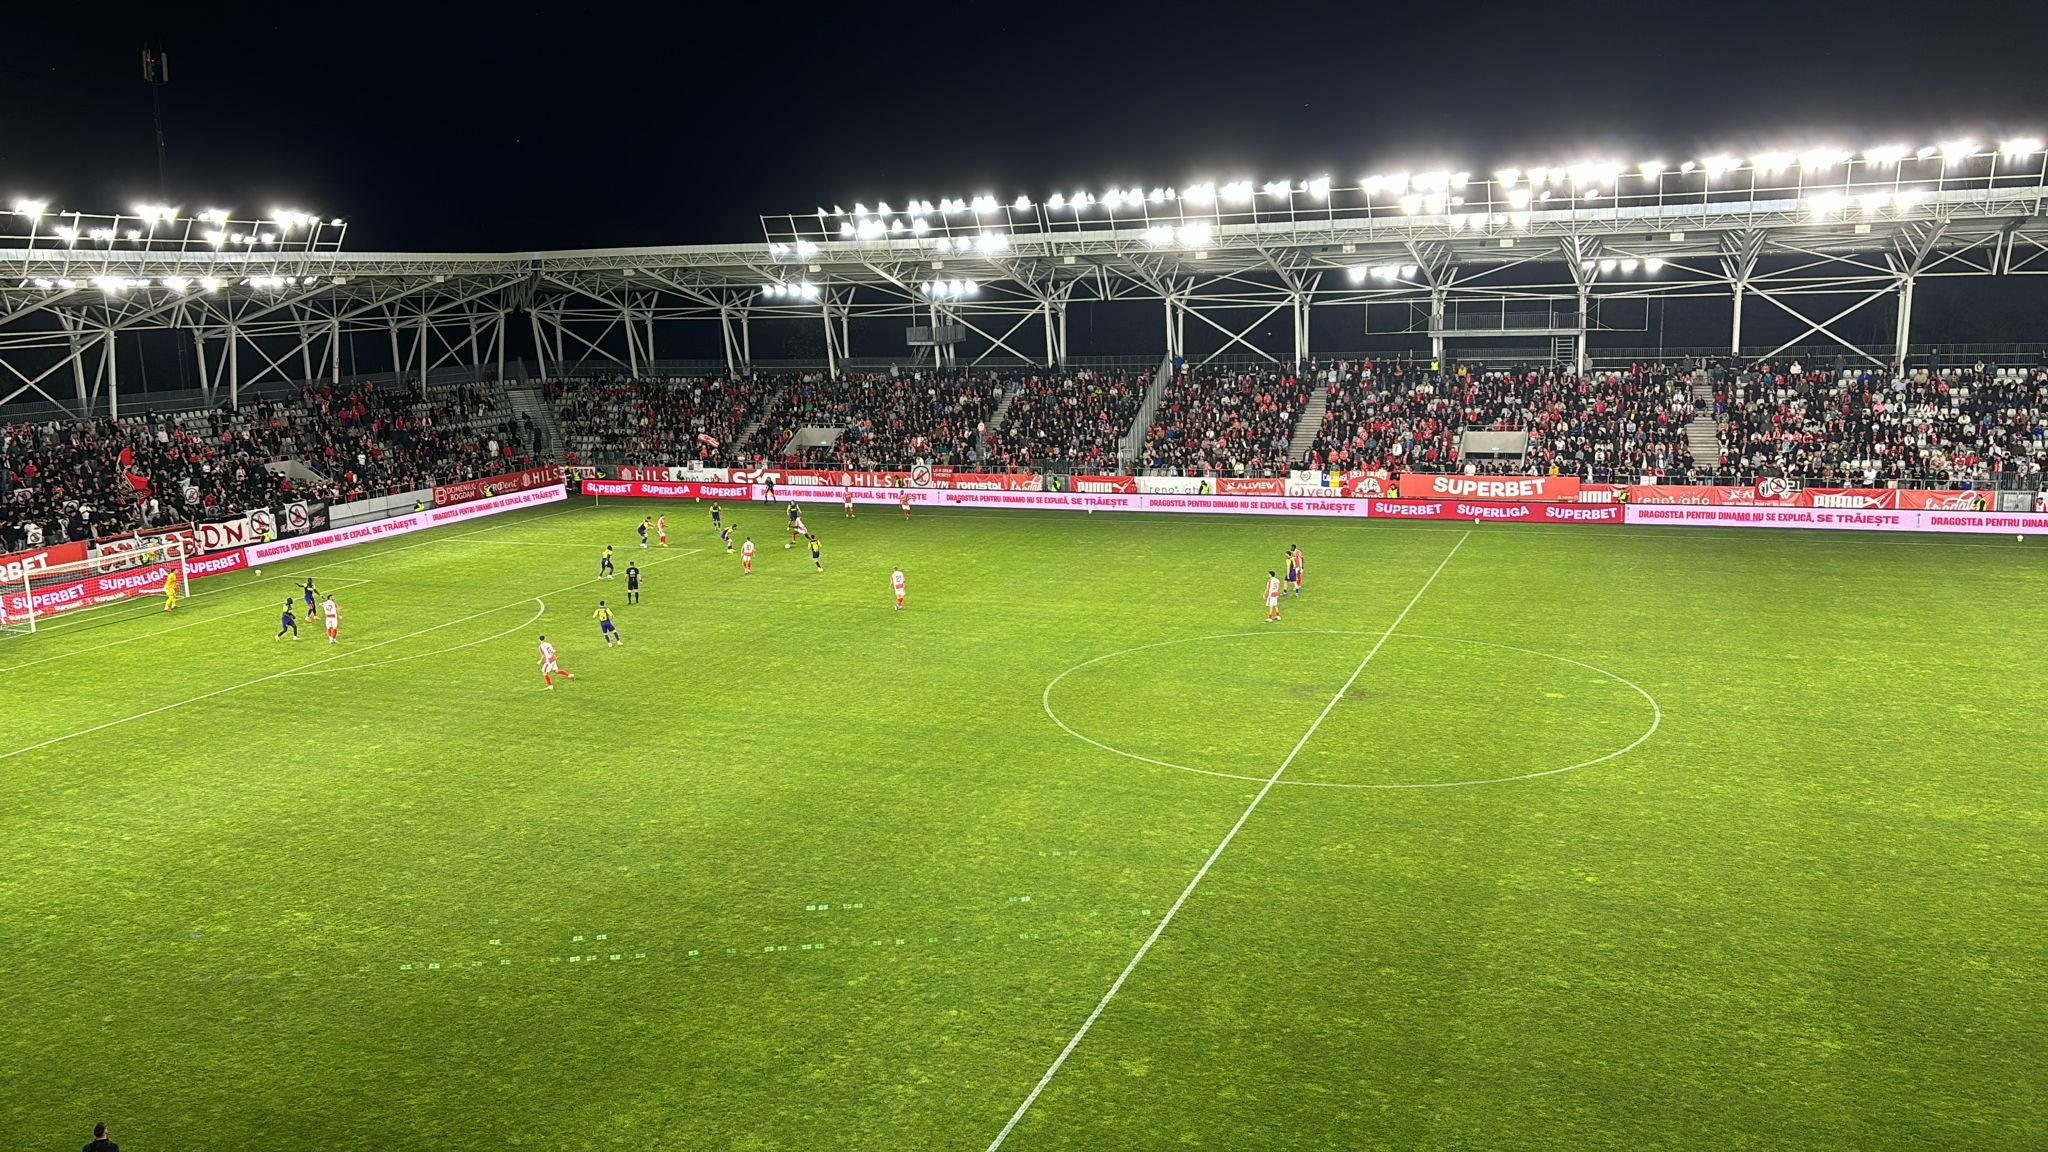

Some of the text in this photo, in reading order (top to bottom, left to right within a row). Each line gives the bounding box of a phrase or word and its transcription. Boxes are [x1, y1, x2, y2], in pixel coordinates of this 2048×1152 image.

[533, 468, 558, 484] HILS
[635, 468, 669, 482] HILS
[855, 474, 892, 488] HILS
[587, 483, 632, 493] SUPERBET
[642, 484, 690, 494] SUPERLIGA
[700, 486, 747, 496] SUPERBET
[1077, 482, 1112, 492] PUMA
[1433, 476, 1546, 496] SUPERBET
[1188, 500, 1211, 508] PENTRU
[1375, 502, 1442, 515] SUPERBET
[1456, 504, 1530, 518] SUPERLIGA
[1546, 506, 1617, 520] SUPERBET
[1638, 510, 1684, 519] DRAGOSTEA
[1718, 512, 1750, 520] DINAMO
[1778, 512, 1814, 522] EXPLICĂ,
[1836, 513, 1900, 526] TRĂIEȘTE
[1931, 517, 1983, 526] DRAGOSTEA
[1986, 518, 2019, 526] PENTRU
[256, 546, 290, 558] DRAGOSTEA
[291, 541, 312, 551] PENTRU
[313, 536, 334, 547] DINAMO
[373, 525, 382, 534] SE
[182, 552, 242, 574] SUPERBET
[99, 567, 168, 590] SUPERLIGA
[12, 584, 85, 609] SUPERBET
